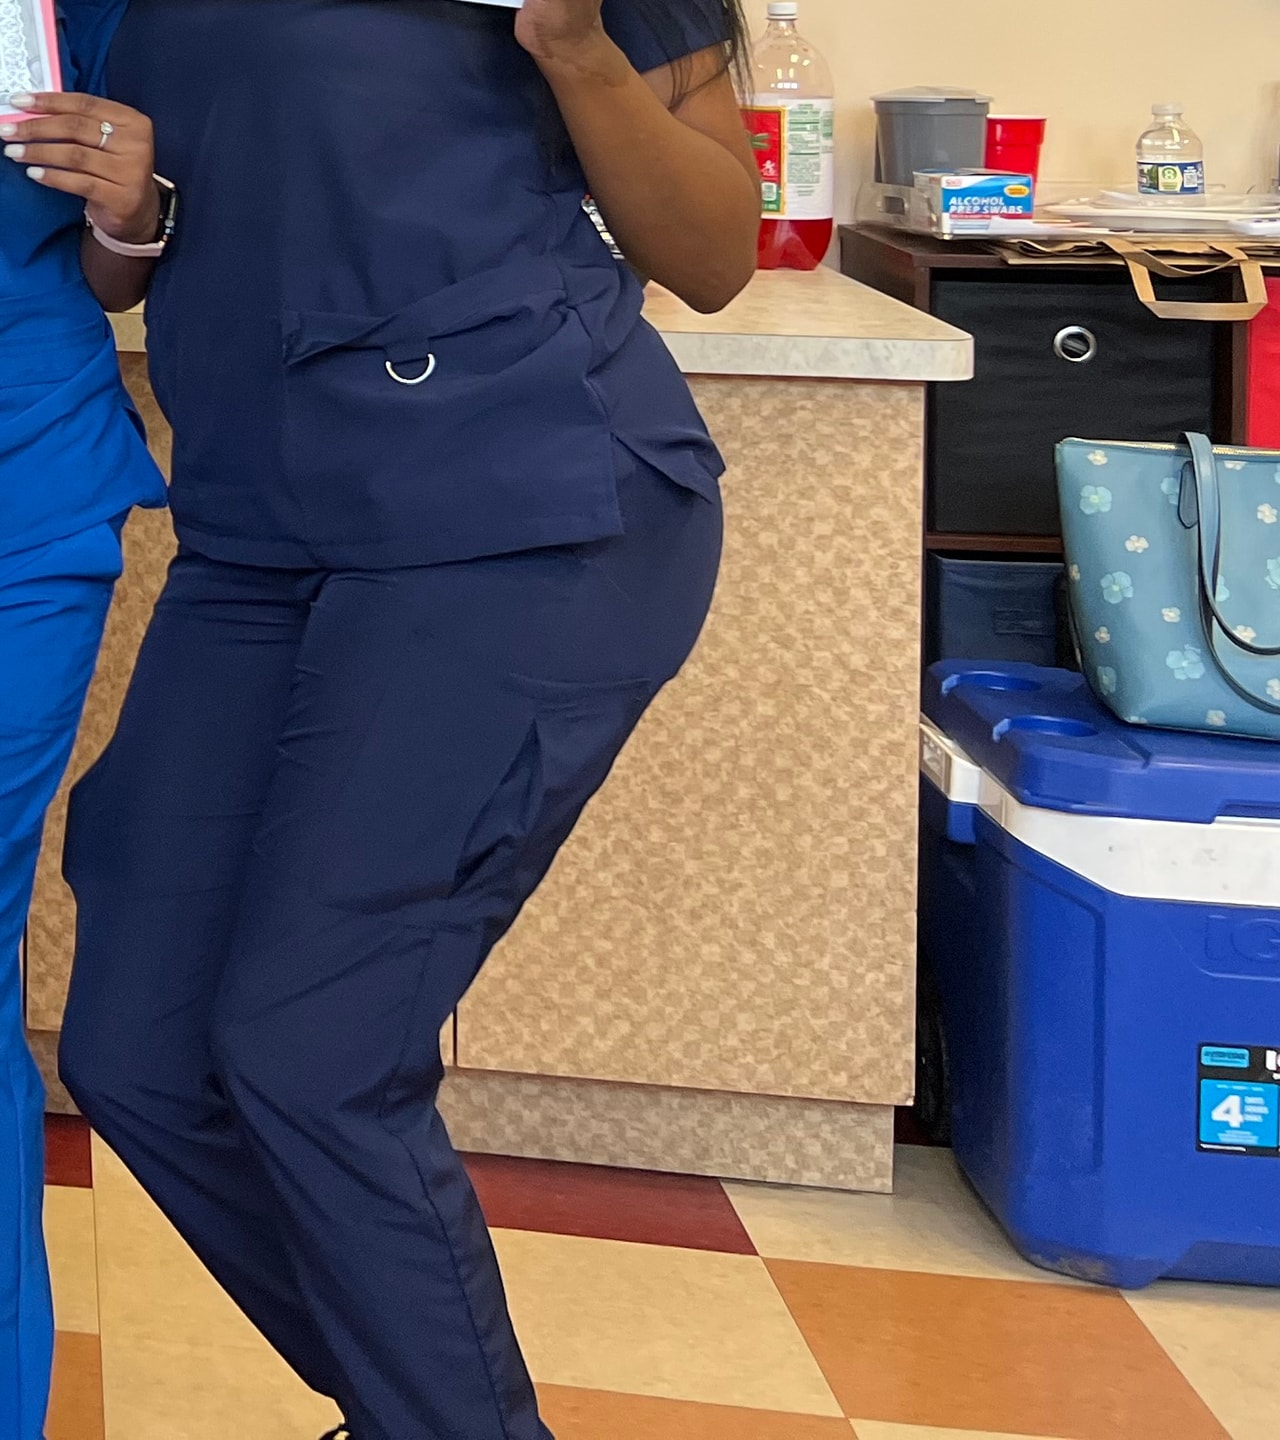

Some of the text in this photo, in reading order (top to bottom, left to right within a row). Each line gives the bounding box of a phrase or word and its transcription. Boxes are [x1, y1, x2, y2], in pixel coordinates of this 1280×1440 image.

[949, 197, 1005, 205] ALCOHOL
[949, 205, 1023, 214] PREP SWABS
[1211, 1094, 1244, 1128] 4
